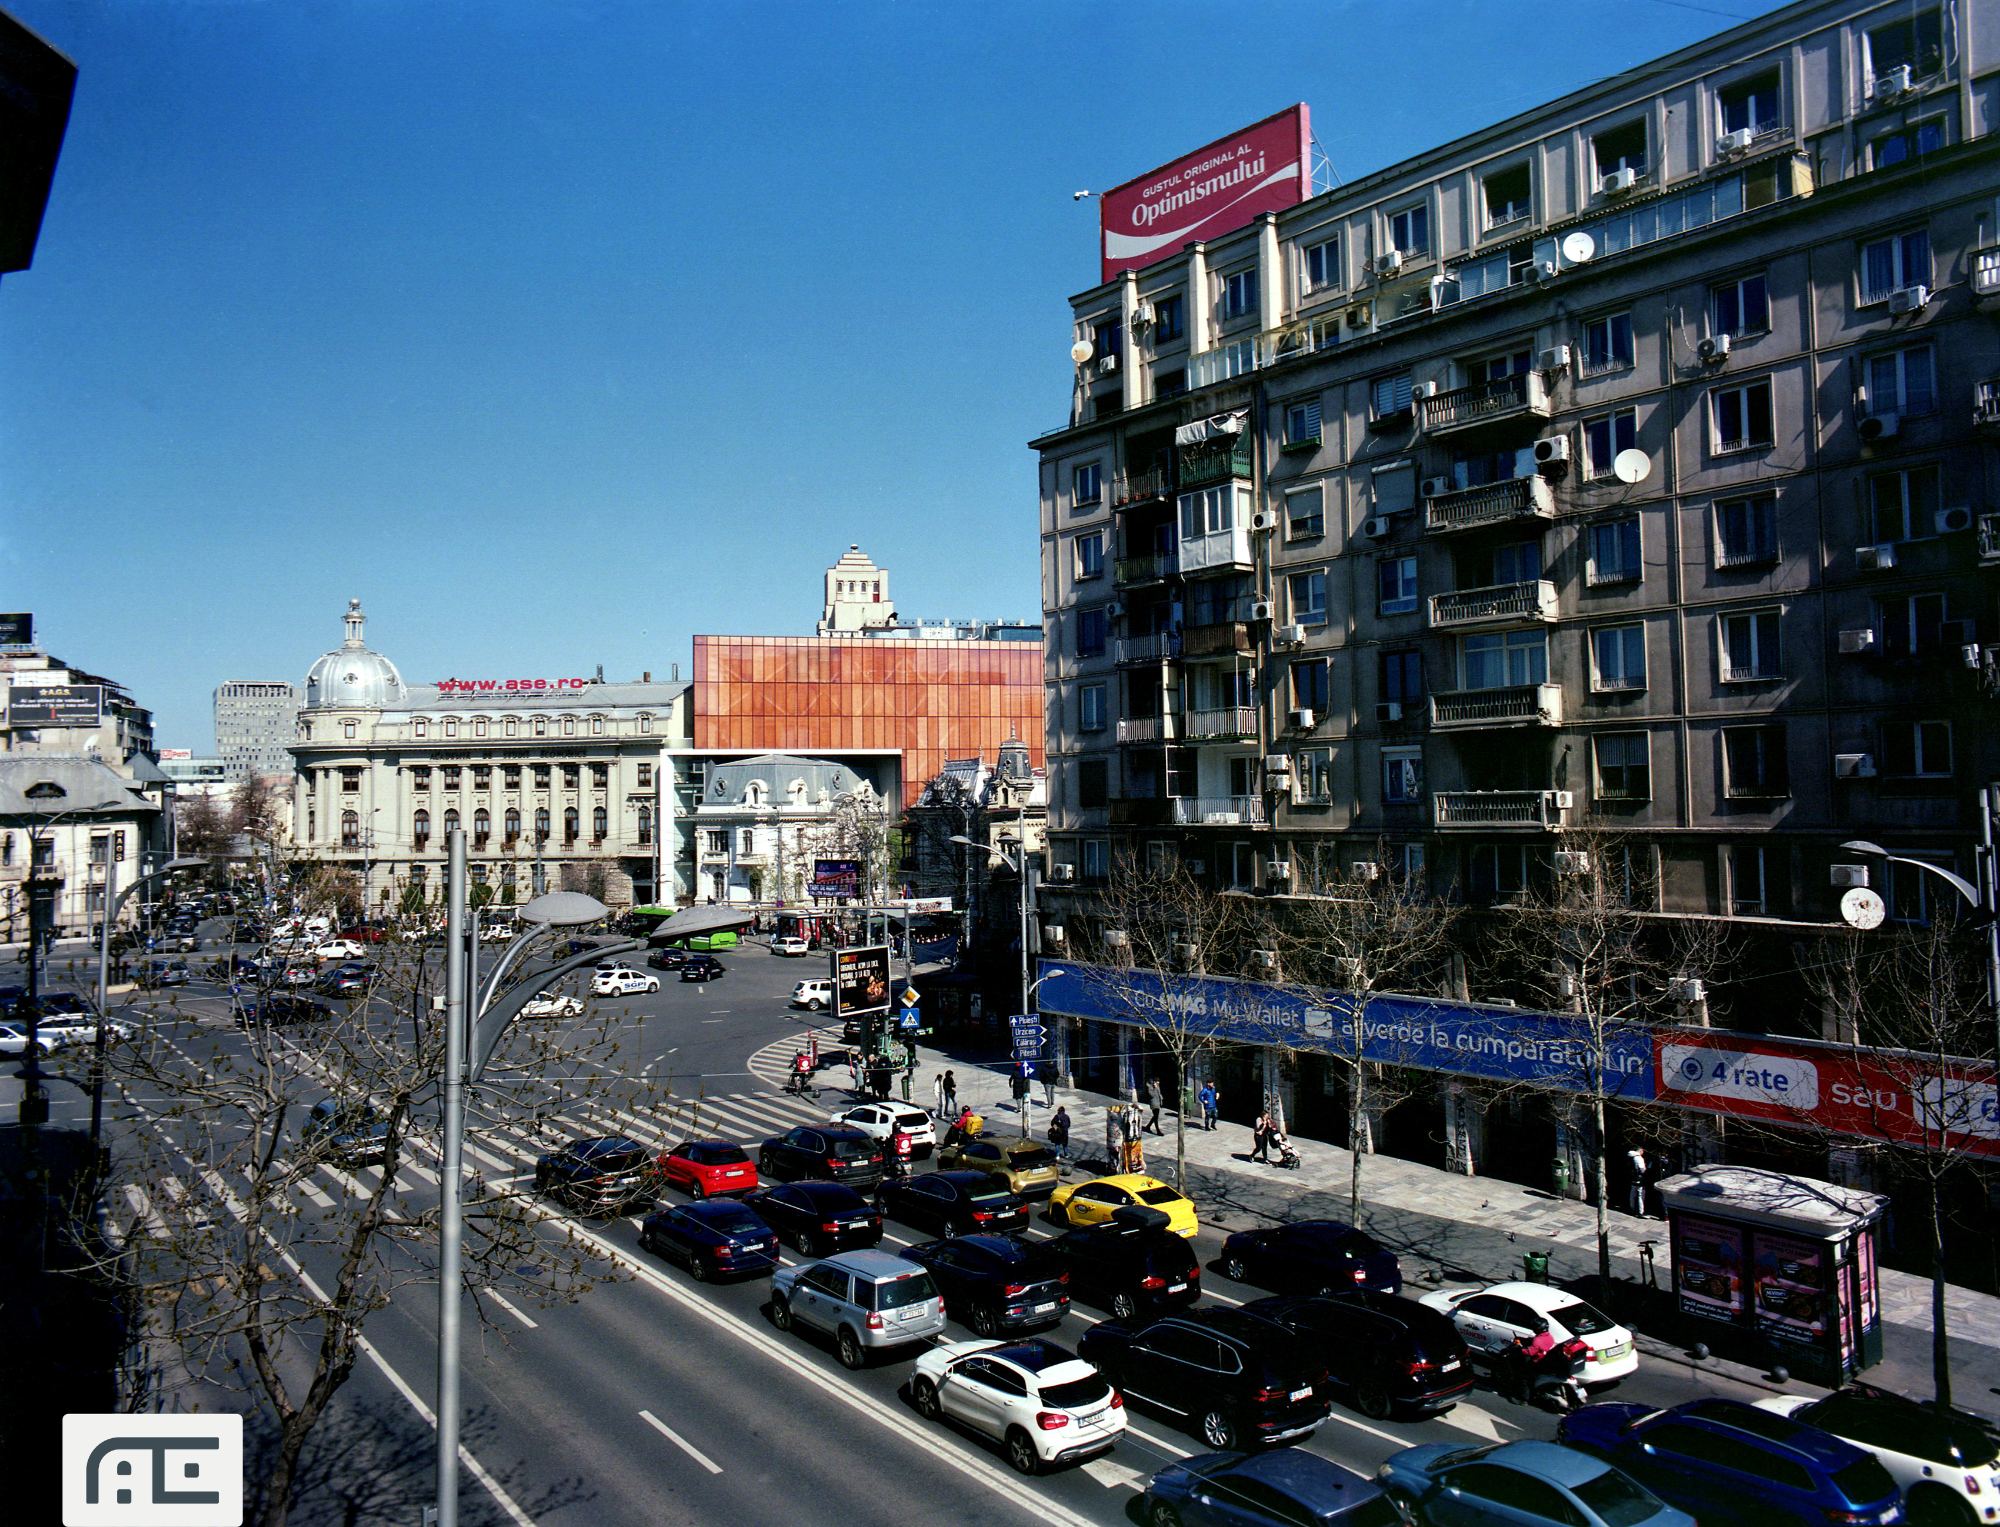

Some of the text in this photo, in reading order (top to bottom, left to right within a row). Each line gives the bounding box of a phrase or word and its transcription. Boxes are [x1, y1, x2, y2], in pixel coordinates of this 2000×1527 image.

[1132, 151, 1265, 226] Optimismului
[1143, 143, 1252, 198] GUSTUL ORIGINAL AL
[437, 678, 583, 691] www.ase.ro
[1243, 1002, 1299, 1028] Wallet
[1430, 1022, 1449, 1048] la
[1617, 1047, 1644, 1074] în
[1712, 1062, 1727, 1082] 4
[1734, 1067, 1788, 1092] rate
[1831, 1081, 1897, 1111] sau
